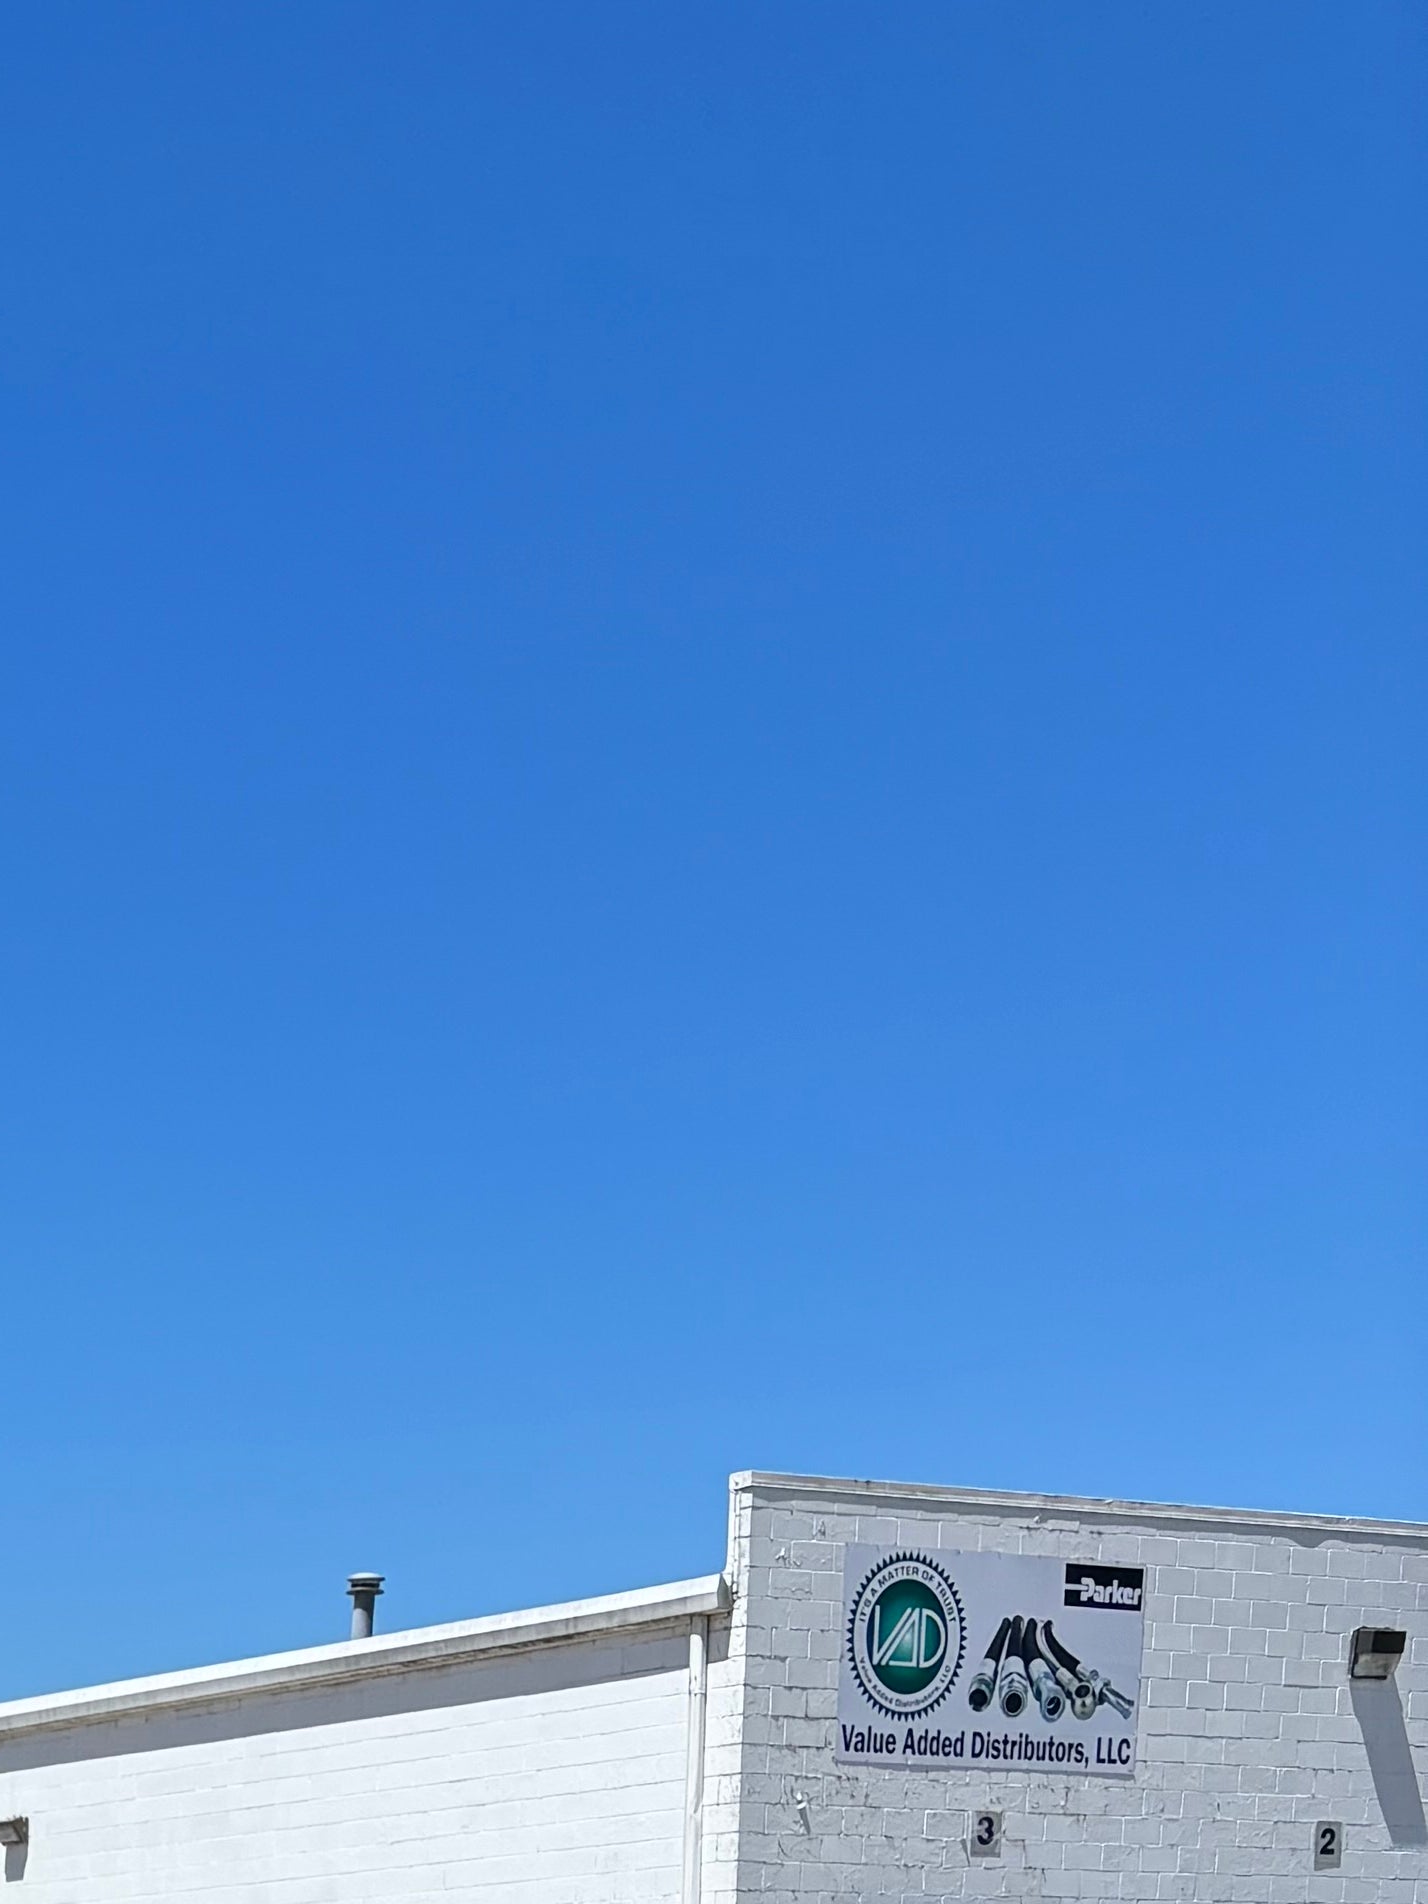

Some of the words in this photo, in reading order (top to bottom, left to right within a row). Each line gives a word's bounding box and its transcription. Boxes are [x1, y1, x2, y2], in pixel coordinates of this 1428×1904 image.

[870, 1587, 879, 1600] A
[877, 1565, 920, 1588] MATTER
[920, 1570, 937, 1584] OF
[1079, 1576, 1142, 1606] Parker
[841, 1724, 897, 1755] Value
[902, 1728, 966, 1759] Added
[971, 1731, 1090, 1770] Distributors,
[1096, 1736, 1132, 1766] LLC
[976, 1815, 995, 1847] 3
[1319, 1827, 1336, 1856] 2
